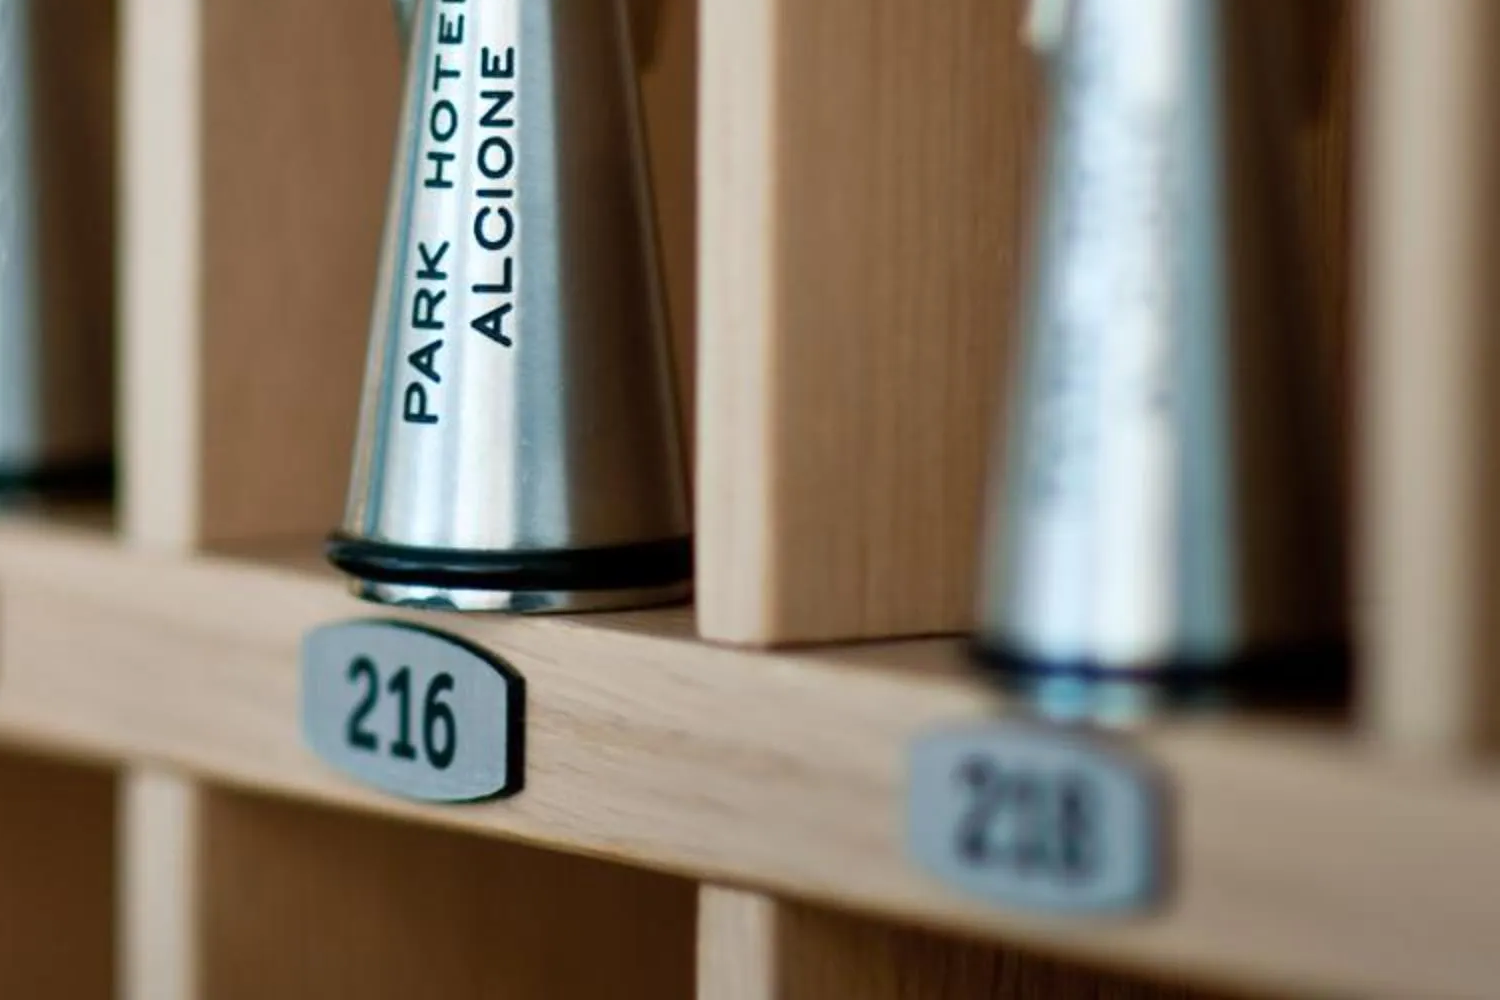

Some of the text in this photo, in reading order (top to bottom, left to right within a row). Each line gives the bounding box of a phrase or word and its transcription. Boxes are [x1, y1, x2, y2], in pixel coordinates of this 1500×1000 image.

[470, 46, 515, 348] ALCIONE
[403, 241, 450, 425] PARK
[346, 652, 457, 770] 216
[951, 752, 1102, 886] 218
